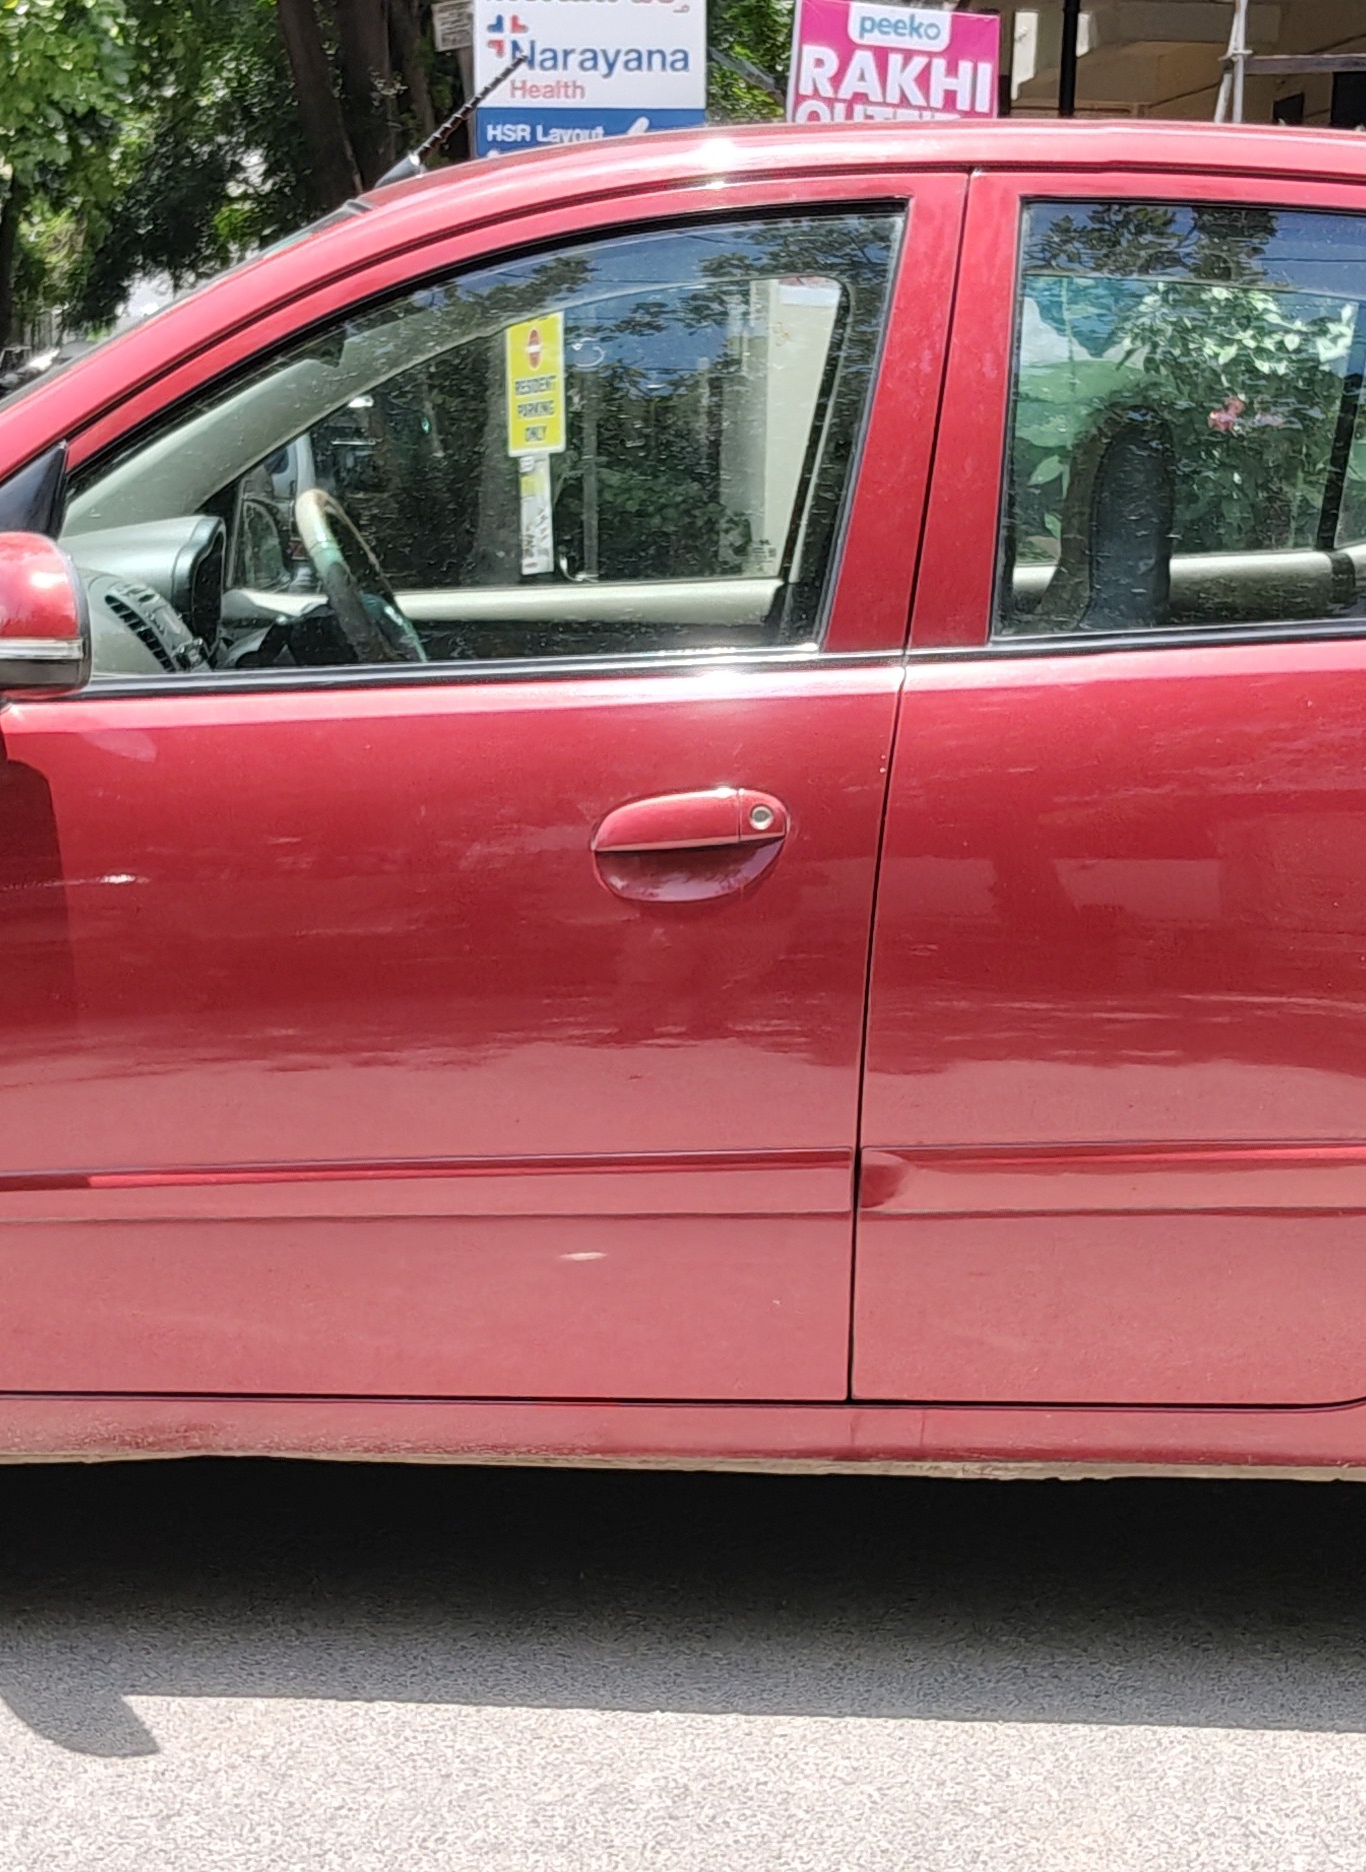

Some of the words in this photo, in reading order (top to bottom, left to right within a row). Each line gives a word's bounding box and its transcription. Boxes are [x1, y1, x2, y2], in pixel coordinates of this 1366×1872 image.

[858, 14, 941, 40] peeko
[511, 40, 691, 78] Narayana
[509, 80, 585, 99] Health
[798, 44, 993, 114] RAKHI
[486, 124, 531, 142] HSR
